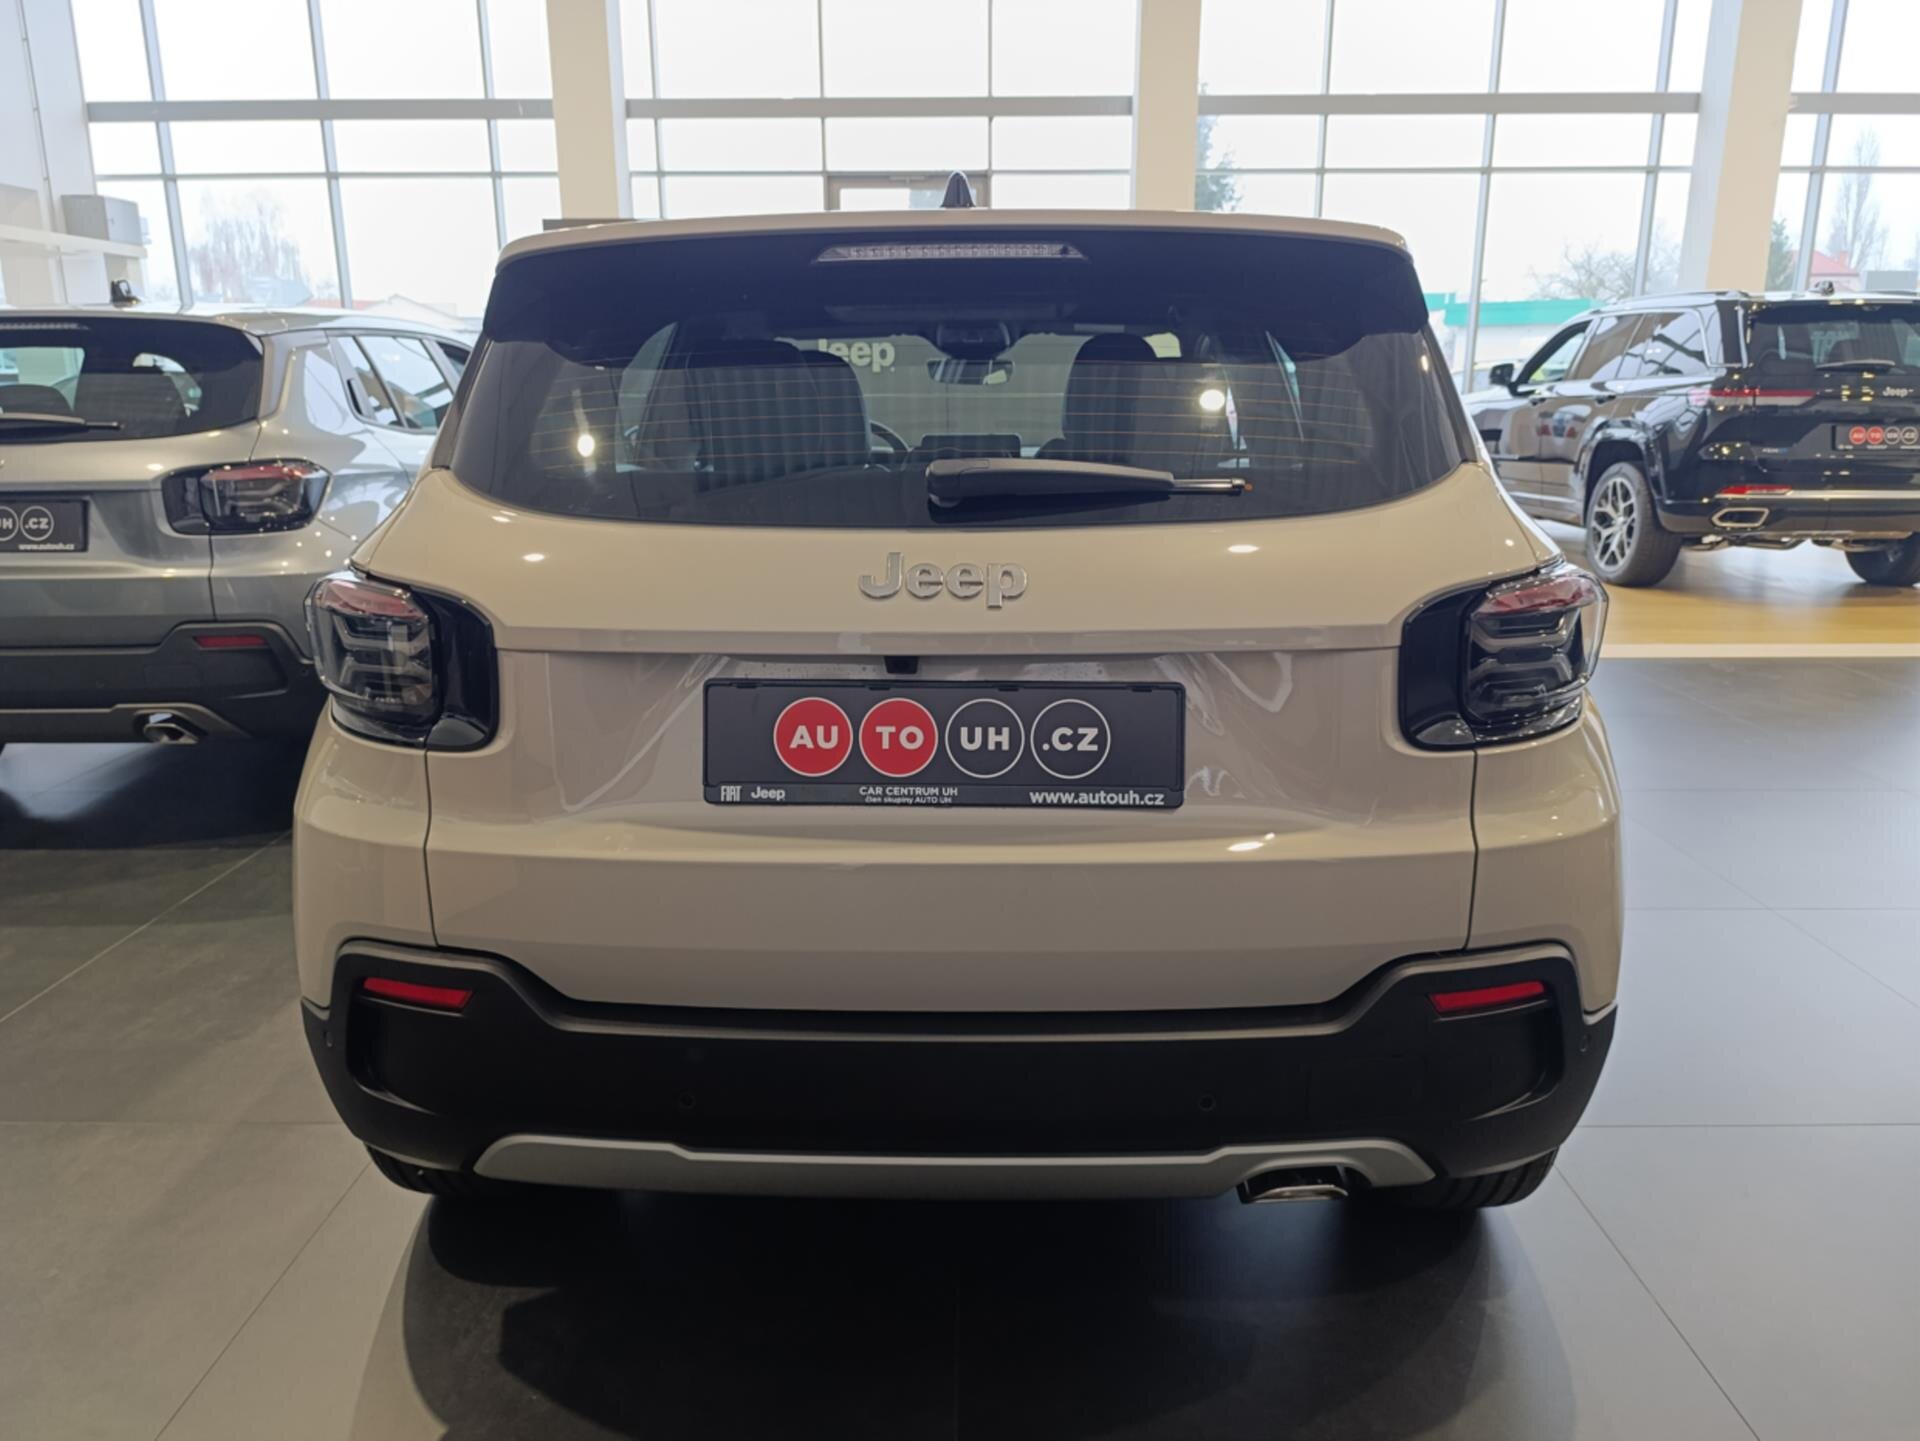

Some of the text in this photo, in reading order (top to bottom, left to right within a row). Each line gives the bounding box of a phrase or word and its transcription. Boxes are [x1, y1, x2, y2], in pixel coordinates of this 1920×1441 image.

[1882, 386, 1908, 398] Jeep
[24, 517, 49, 529] .CZ
[858, 551, 1027, 609] Jeep
[789, 725, 1099, 751] AU TO UH .CZ
[720, 785, 786, 802] FIAT Jeep
[859, 786, 958, 796] CAR CENTRUM UH
[1029, 790, 1164, 806] www.autouh.cz
